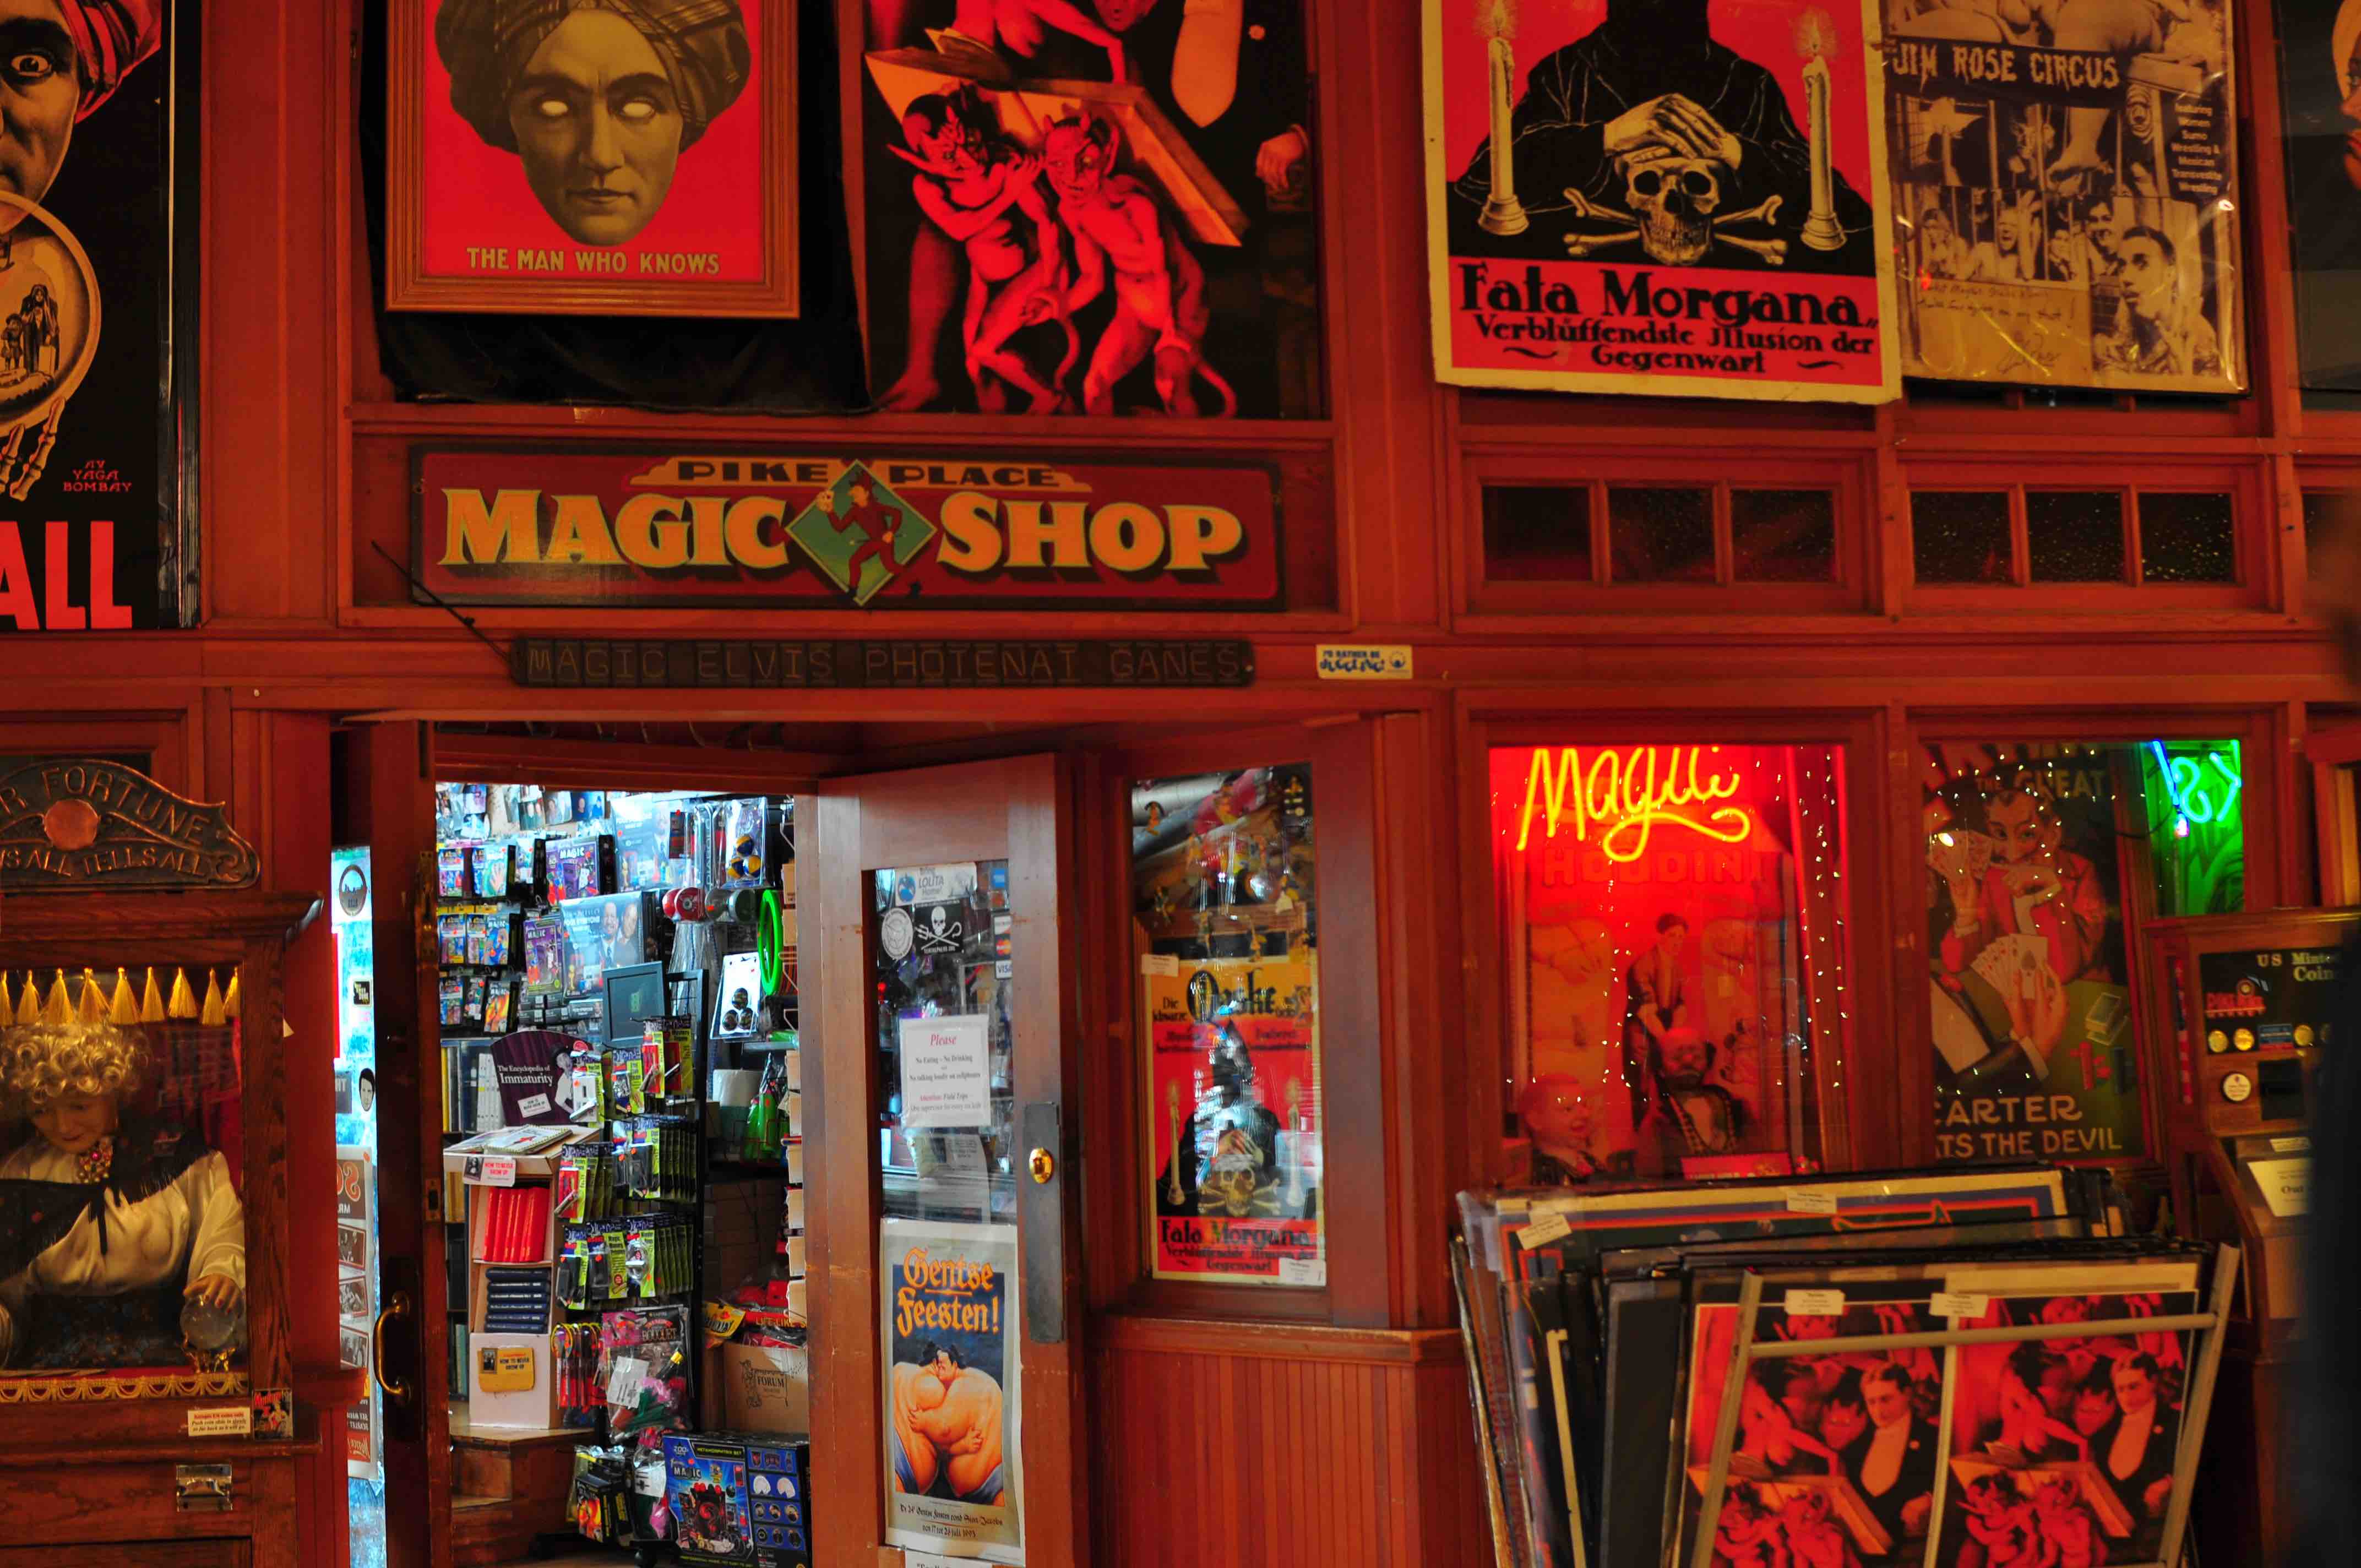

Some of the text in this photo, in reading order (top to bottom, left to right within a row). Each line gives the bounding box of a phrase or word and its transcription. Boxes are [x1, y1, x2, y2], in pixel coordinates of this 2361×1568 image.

[1893, 43, 2120, 92] JIM ROSE CIRCUS
[467, 247, 720, 274] THE MAN WHO KNOWS
[1458, 262, 1581, 314] Fata
[1832, 331, 1874, 354] der
[1591, 345, 1766, 372] Gegenwart
[63, 482, 132, 492] BOMBAY
[73, 470, 119, 480] YAGA
[677, 461, 1063, 487] PIKE PLACE
[437, 488, 1242, 572] MAGIC SHOP
[529, 646, 666, 678] MAGIC
[698, 647, 834, 679] ELVIS
[2014, 770, 2103, 802] GREAT
[41, 766, 210, 846] FORTUNE
[929, 1034, 956, 1046] Please
[499, 1073, 553, 1087] Immaturity
[1934, 1096, 2082, 1126] ARTER
[1981, 1131, 2033, 1156] THE
[2043, 1128, 2121, 1154] DEVIL
[758, 1376, 784, 1388] FORUM
